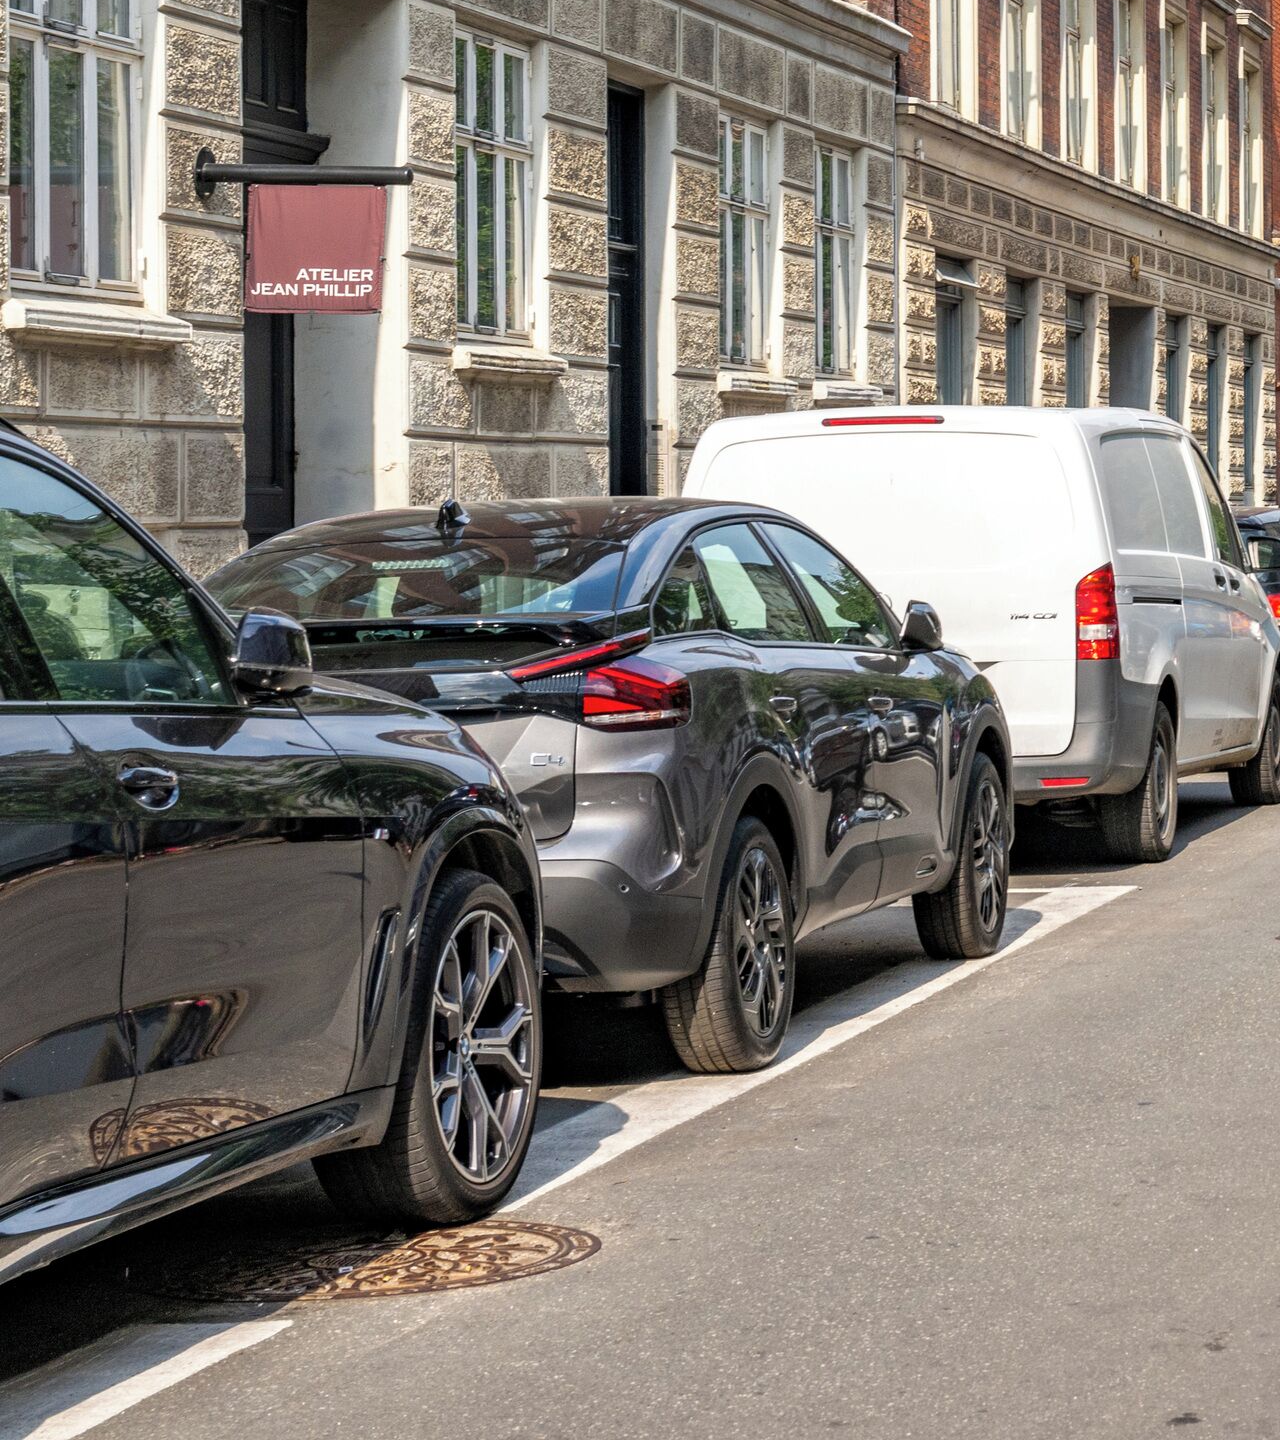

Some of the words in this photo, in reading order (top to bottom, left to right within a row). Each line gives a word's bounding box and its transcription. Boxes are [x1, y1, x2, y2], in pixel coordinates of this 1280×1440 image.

[296, 268, 374, 281] ATELIER
[251, 283, 299, 295] JEAN
[303, 284, 373, 296] PHILLIP
[530, 753, 565, 766] C4
